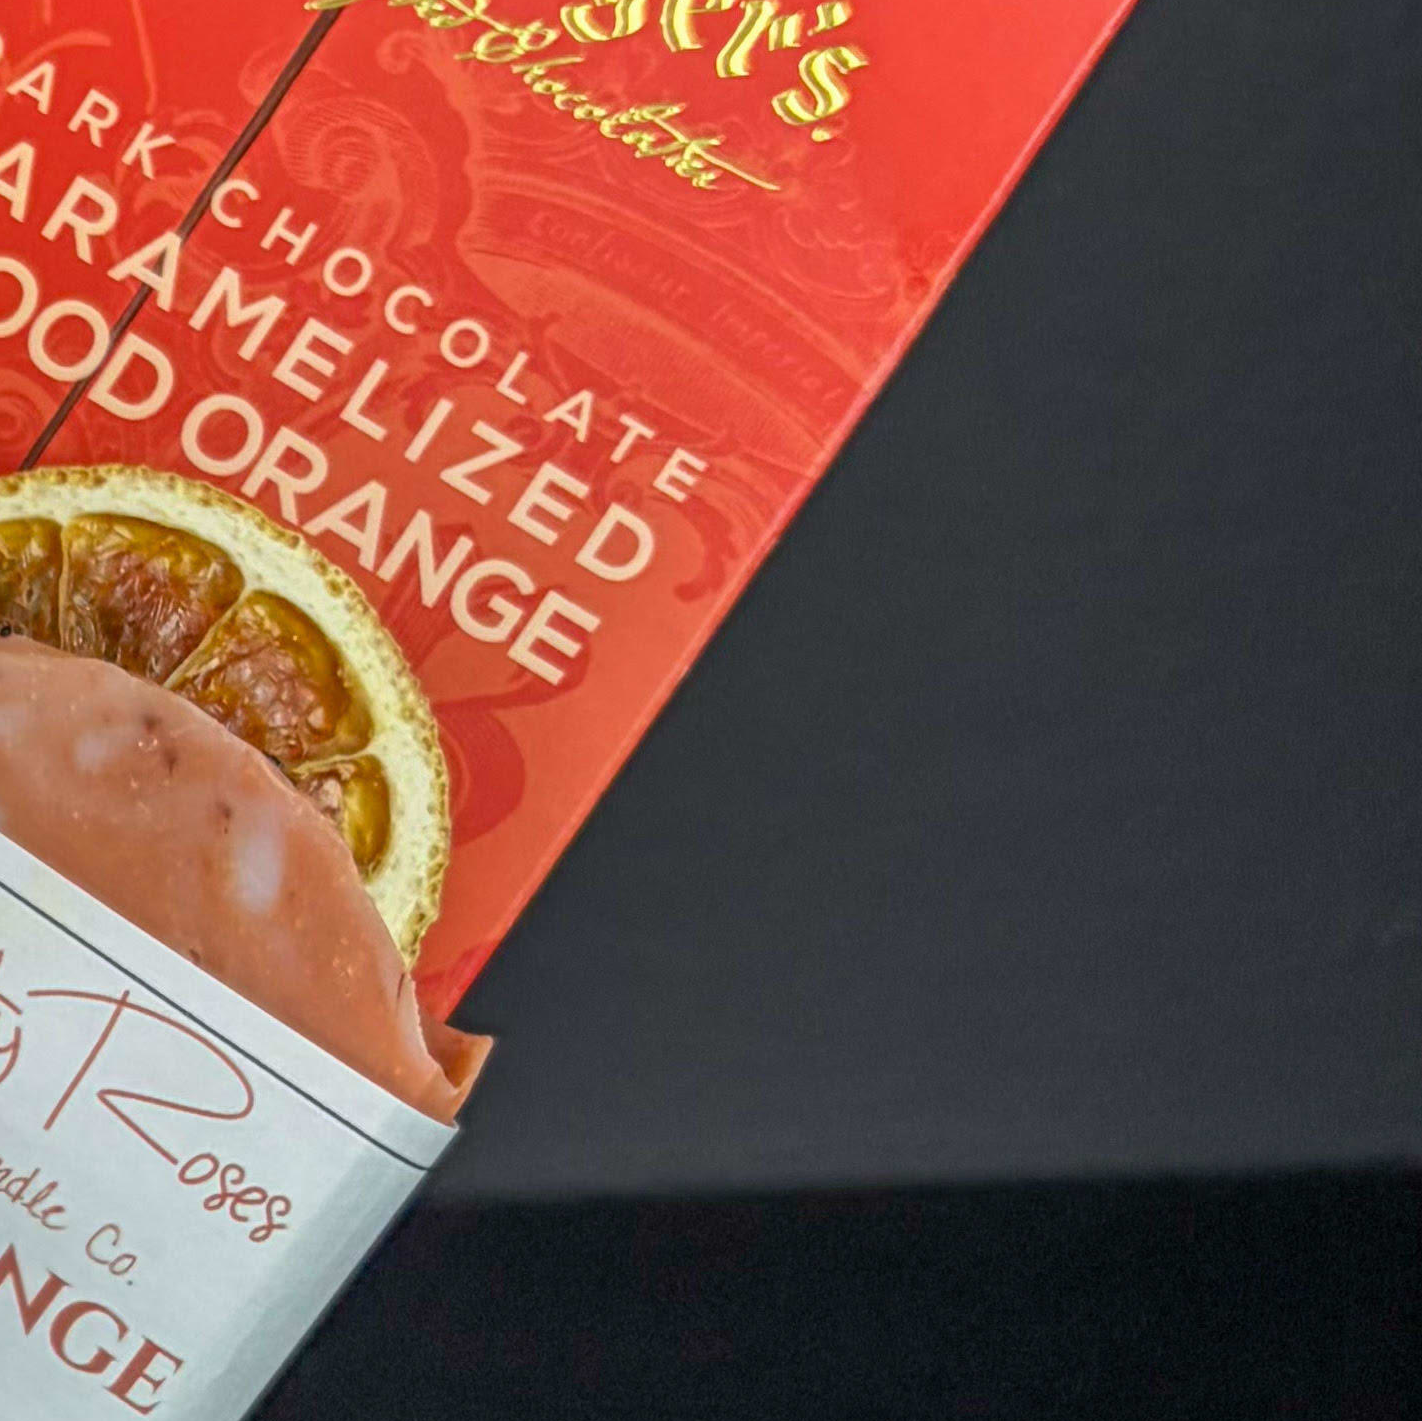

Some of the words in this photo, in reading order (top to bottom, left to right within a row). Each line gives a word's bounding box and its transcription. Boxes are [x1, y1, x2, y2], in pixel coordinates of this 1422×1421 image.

[209, 179, 709, 503] CHOCOLATE
[180, 394, 602, 685] ORANGE
[27, 987, 295, 1246] Roses
[83, 1221, 140, 1288] Co.
